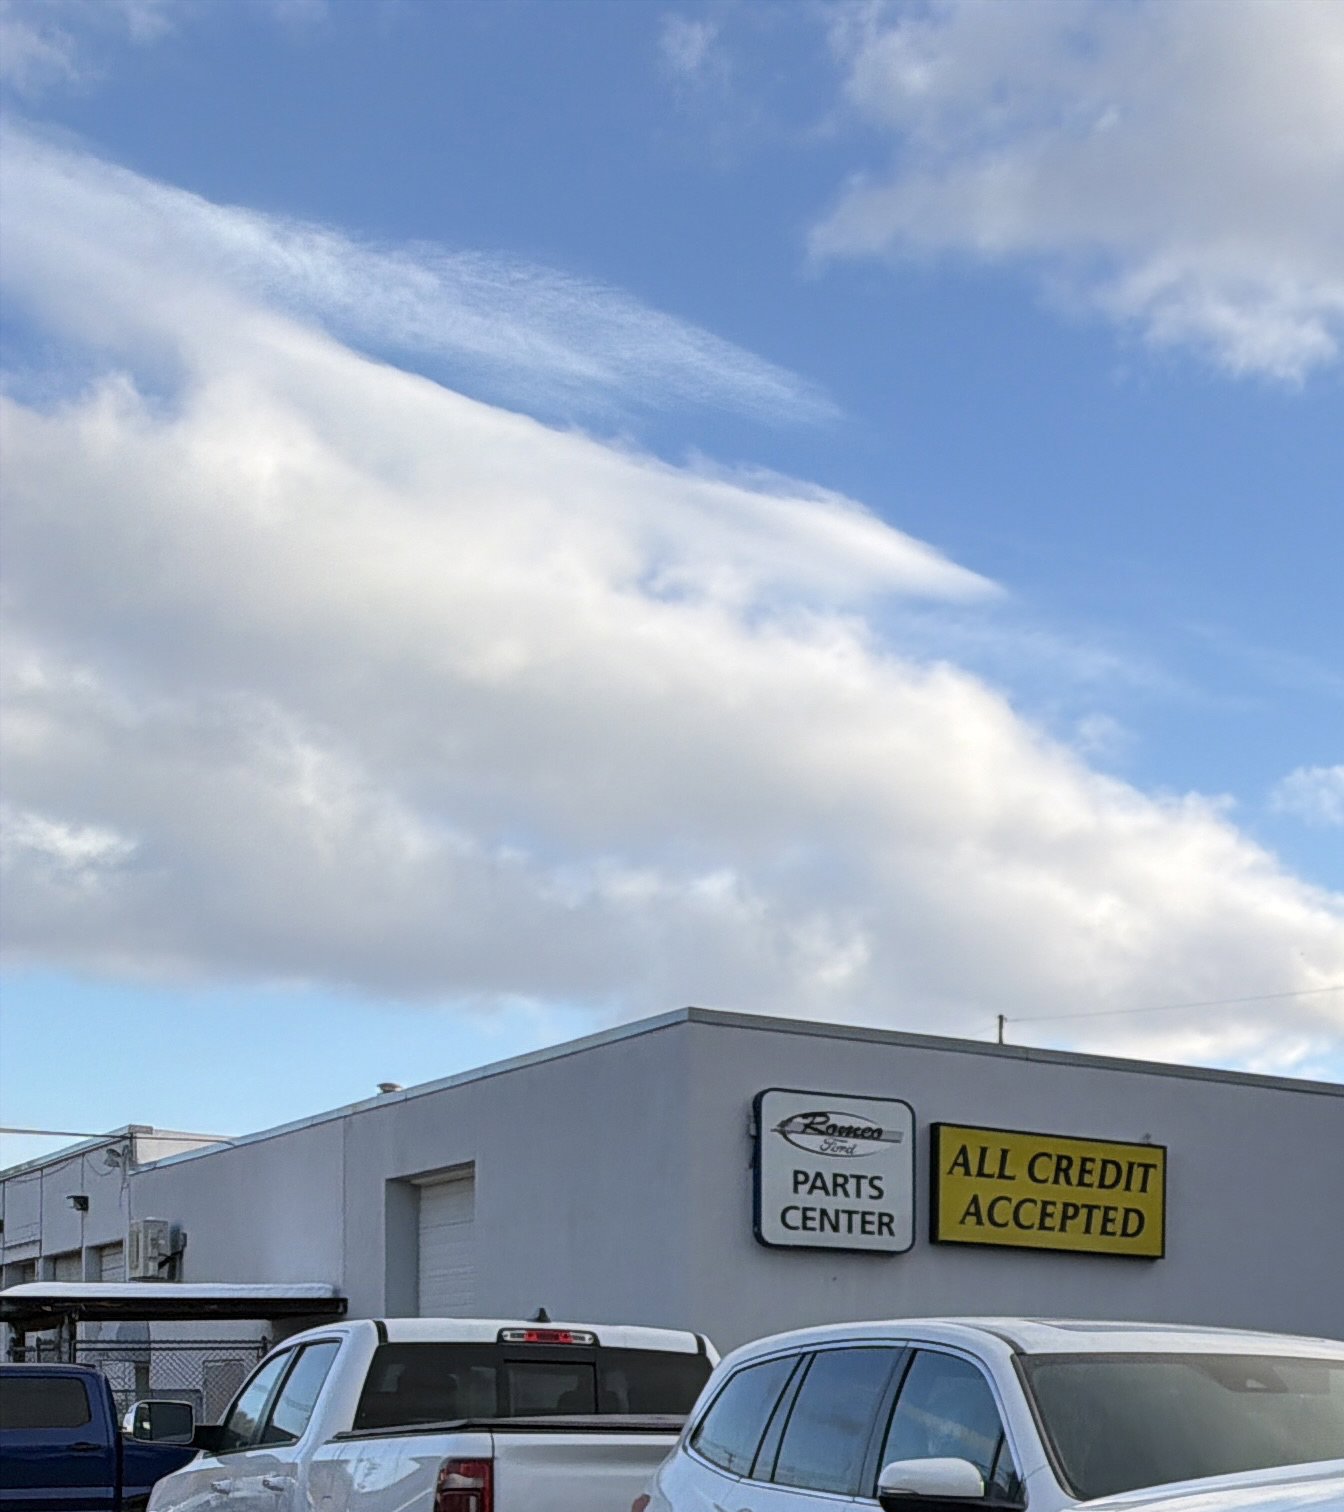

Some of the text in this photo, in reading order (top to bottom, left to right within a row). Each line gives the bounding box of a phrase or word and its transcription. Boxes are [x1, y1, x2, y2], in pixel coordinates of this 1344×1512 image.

[800, 1111, 883, 1140] Romeo
[820, 1138, 857, 1155] Ford
[792, 1169, 885, 1200] PARTS
[947, 1144, 1158, 1194] ALL CREDIT
[780, 1205, 896, 1237] CENTER
[959, 1194, 1146, 1239] ACCEPTED
